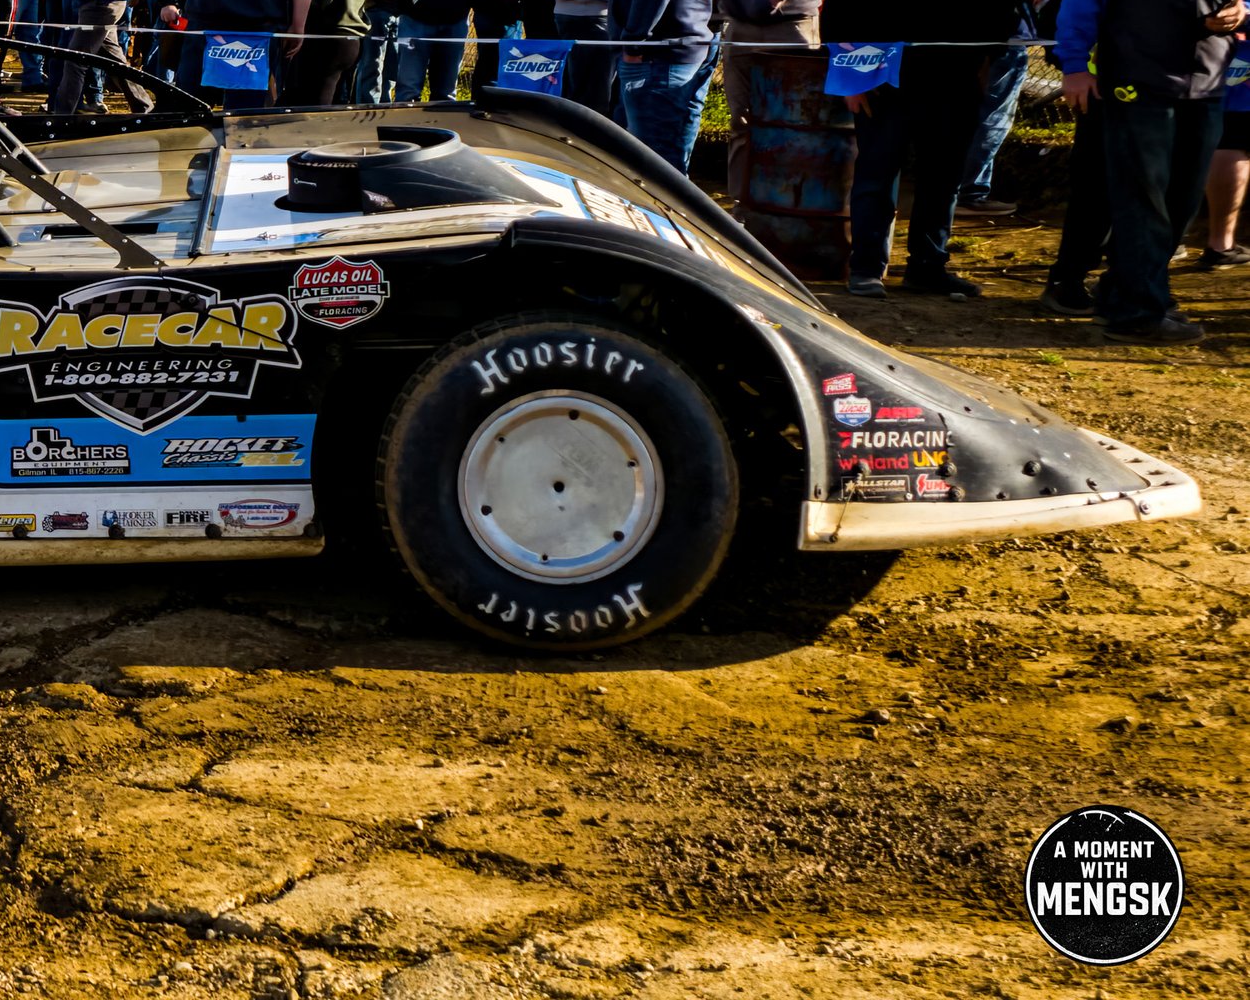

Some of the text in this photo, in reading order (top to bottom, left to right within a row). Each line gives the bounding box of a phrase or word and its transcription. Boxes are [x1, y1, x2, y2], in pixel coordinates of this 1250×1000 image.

[209, 46, 265, 60] SUNOCO
[303, 269, 373, 285] LUCAS OIL
[292, 287, 330, 300] LATE
[332, 284, 386, 296] MODEL
[318, 306, 368, 316] FLORACING
[50, 358, 233, 373] ENGINEERING
[471, 338, 646, 395] Hoosier
[44, 370, 240, 386] 1-800-882-7231
[13, 441, 128, 461] BORCHERS
[163, 437, 297, 453] ROCKET
[163, 451, 238, 465] Chassis
[118, 511, 155, 519] HOOKER
[166, 512, 210, 524] FIRE
[118, 519, 157, 527] HARNESS
